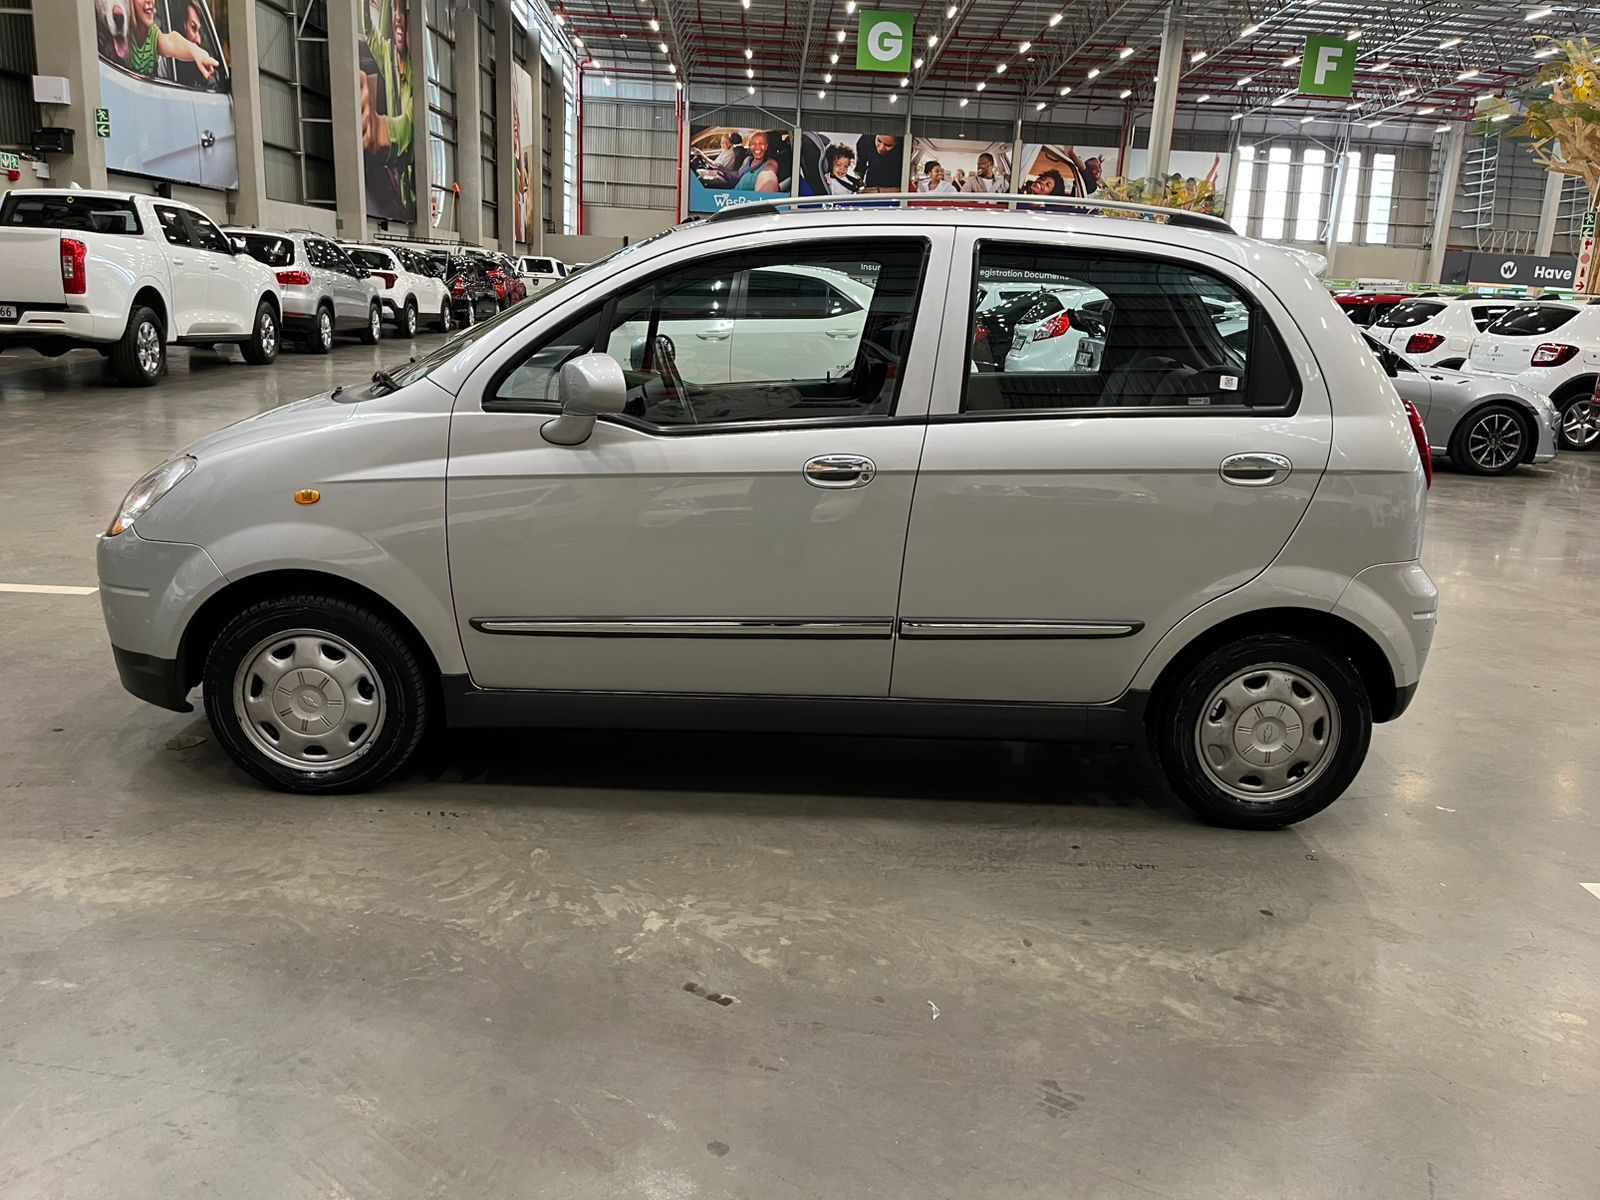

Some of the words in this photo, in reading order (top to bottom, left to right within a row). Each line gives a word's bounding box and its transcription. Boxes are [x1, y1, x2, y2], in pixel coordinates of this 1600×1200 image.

[868, 21, 902, 61] G
[1314, 46, 1343, 85] F
[979, 269, 1022, 278] egistration
[1534, 265, 1573, 280] Have
